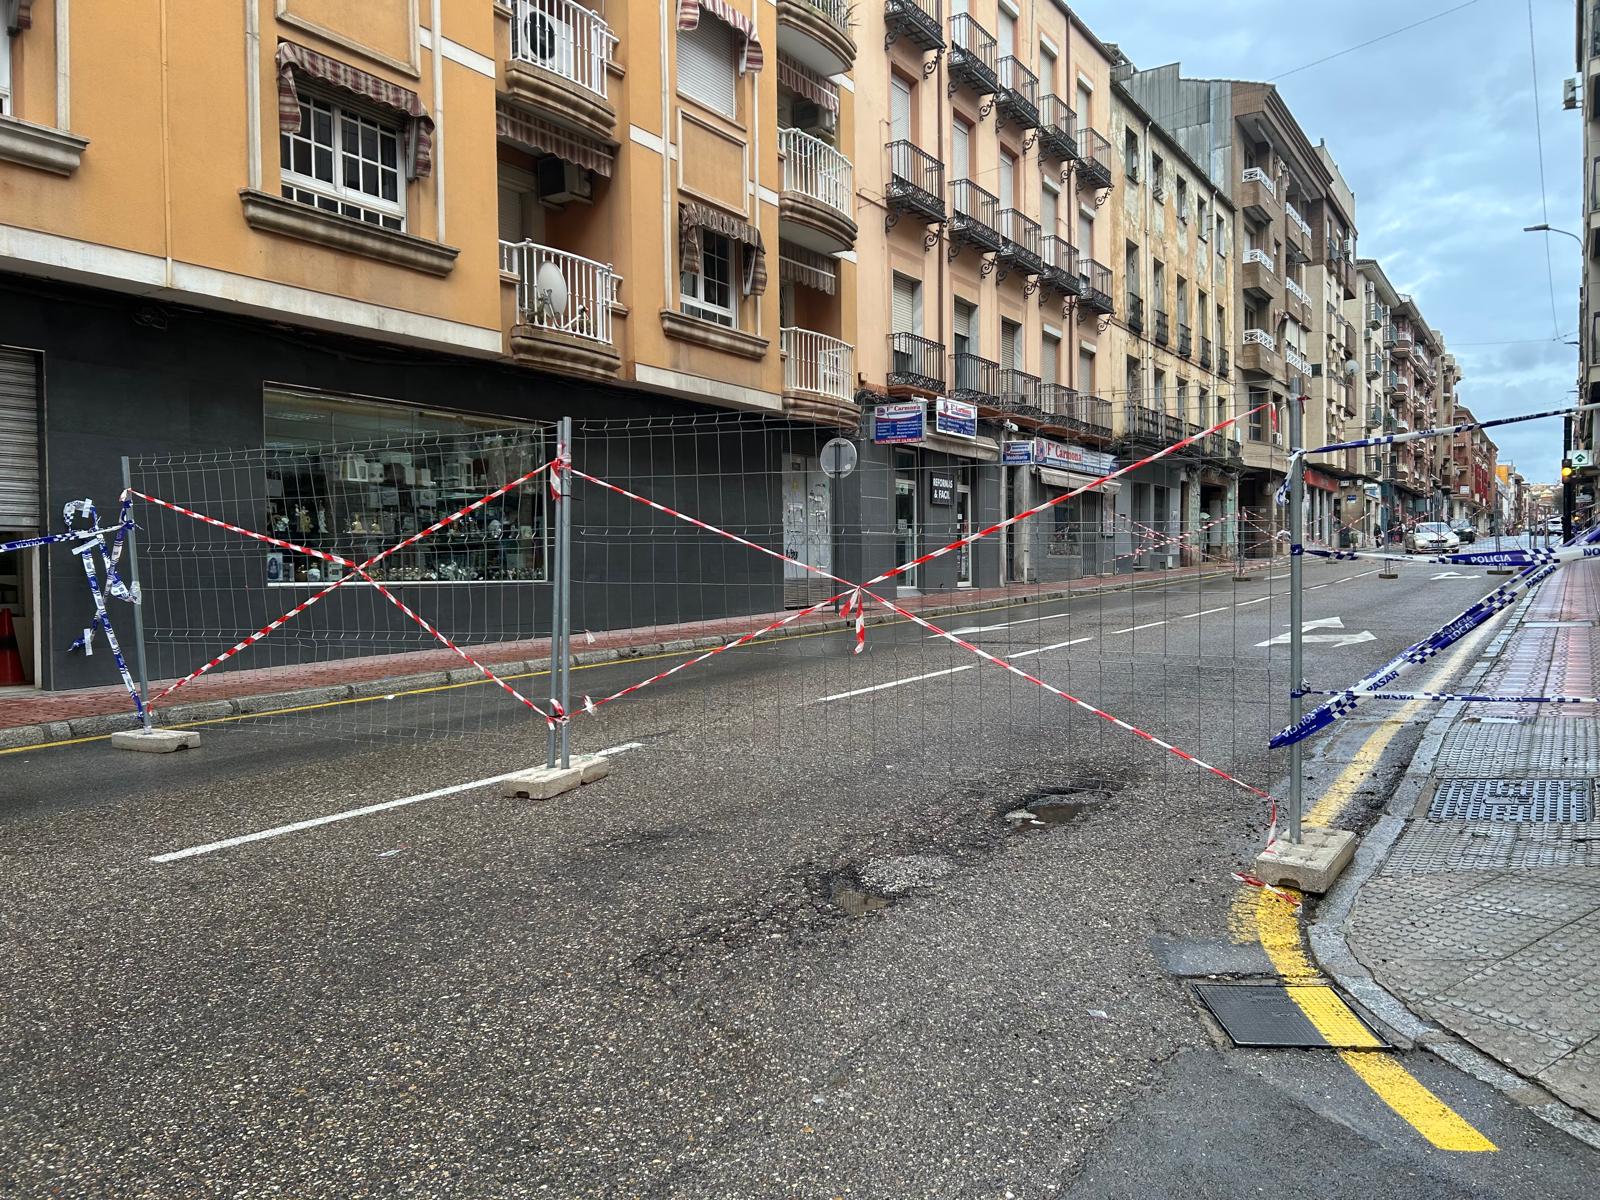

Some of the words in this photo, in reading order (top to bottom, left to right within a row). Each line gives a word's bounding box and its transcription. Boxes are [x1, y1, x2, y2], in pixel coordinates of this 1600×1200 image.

[1470, 554, 1511, 564] POLICIA
[1525, 564, 1557, 590] PASAR
[1449, 620, 1476, 641] LOCAL
[1366, 670, 1400, 692] PASAR
